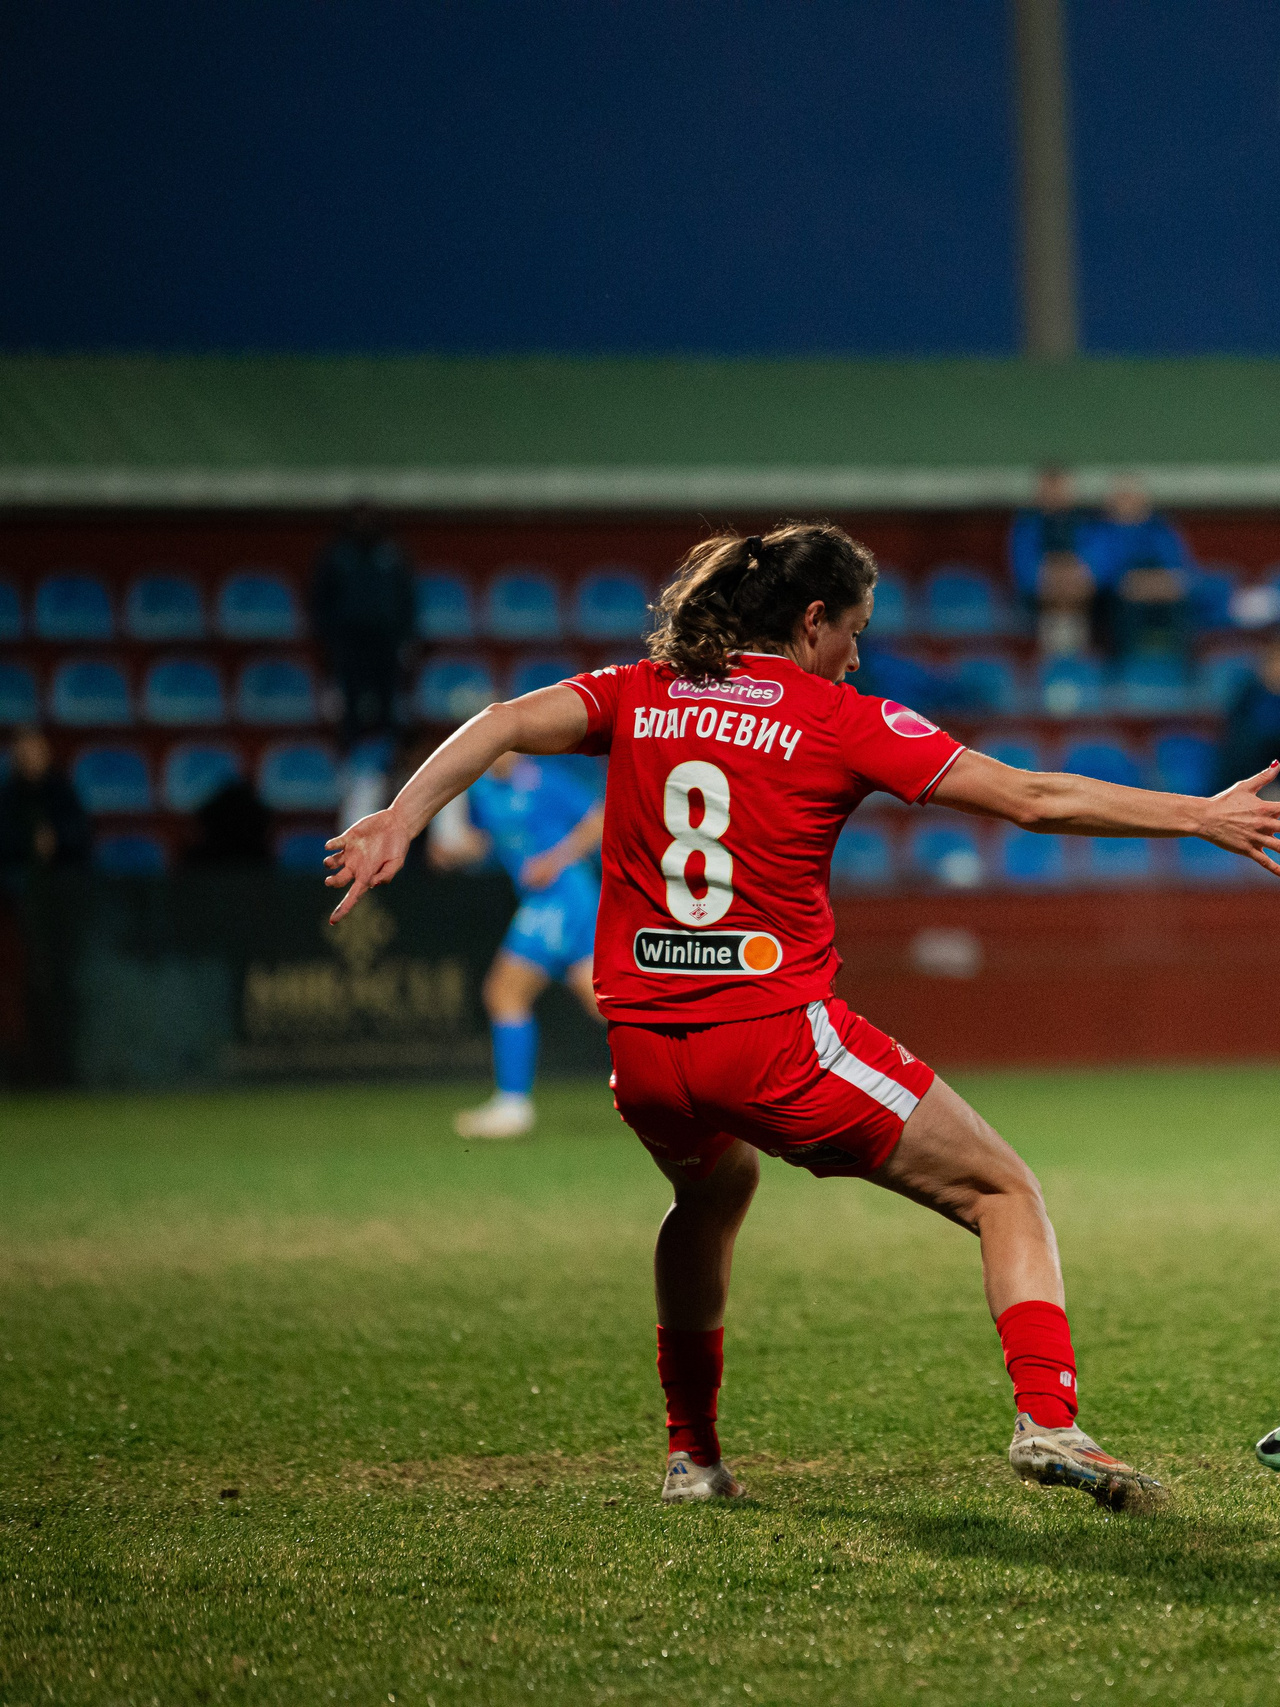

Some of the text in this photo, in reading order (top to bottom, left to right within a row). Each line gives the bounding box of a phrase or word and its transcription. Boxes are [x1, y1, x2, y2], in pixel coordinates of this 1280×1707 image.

[633, 706, 803, 761] БЛАГОЕВИЧ
[660, 760, 735, 928] 8
[641, 938, 732, 965] Winline
